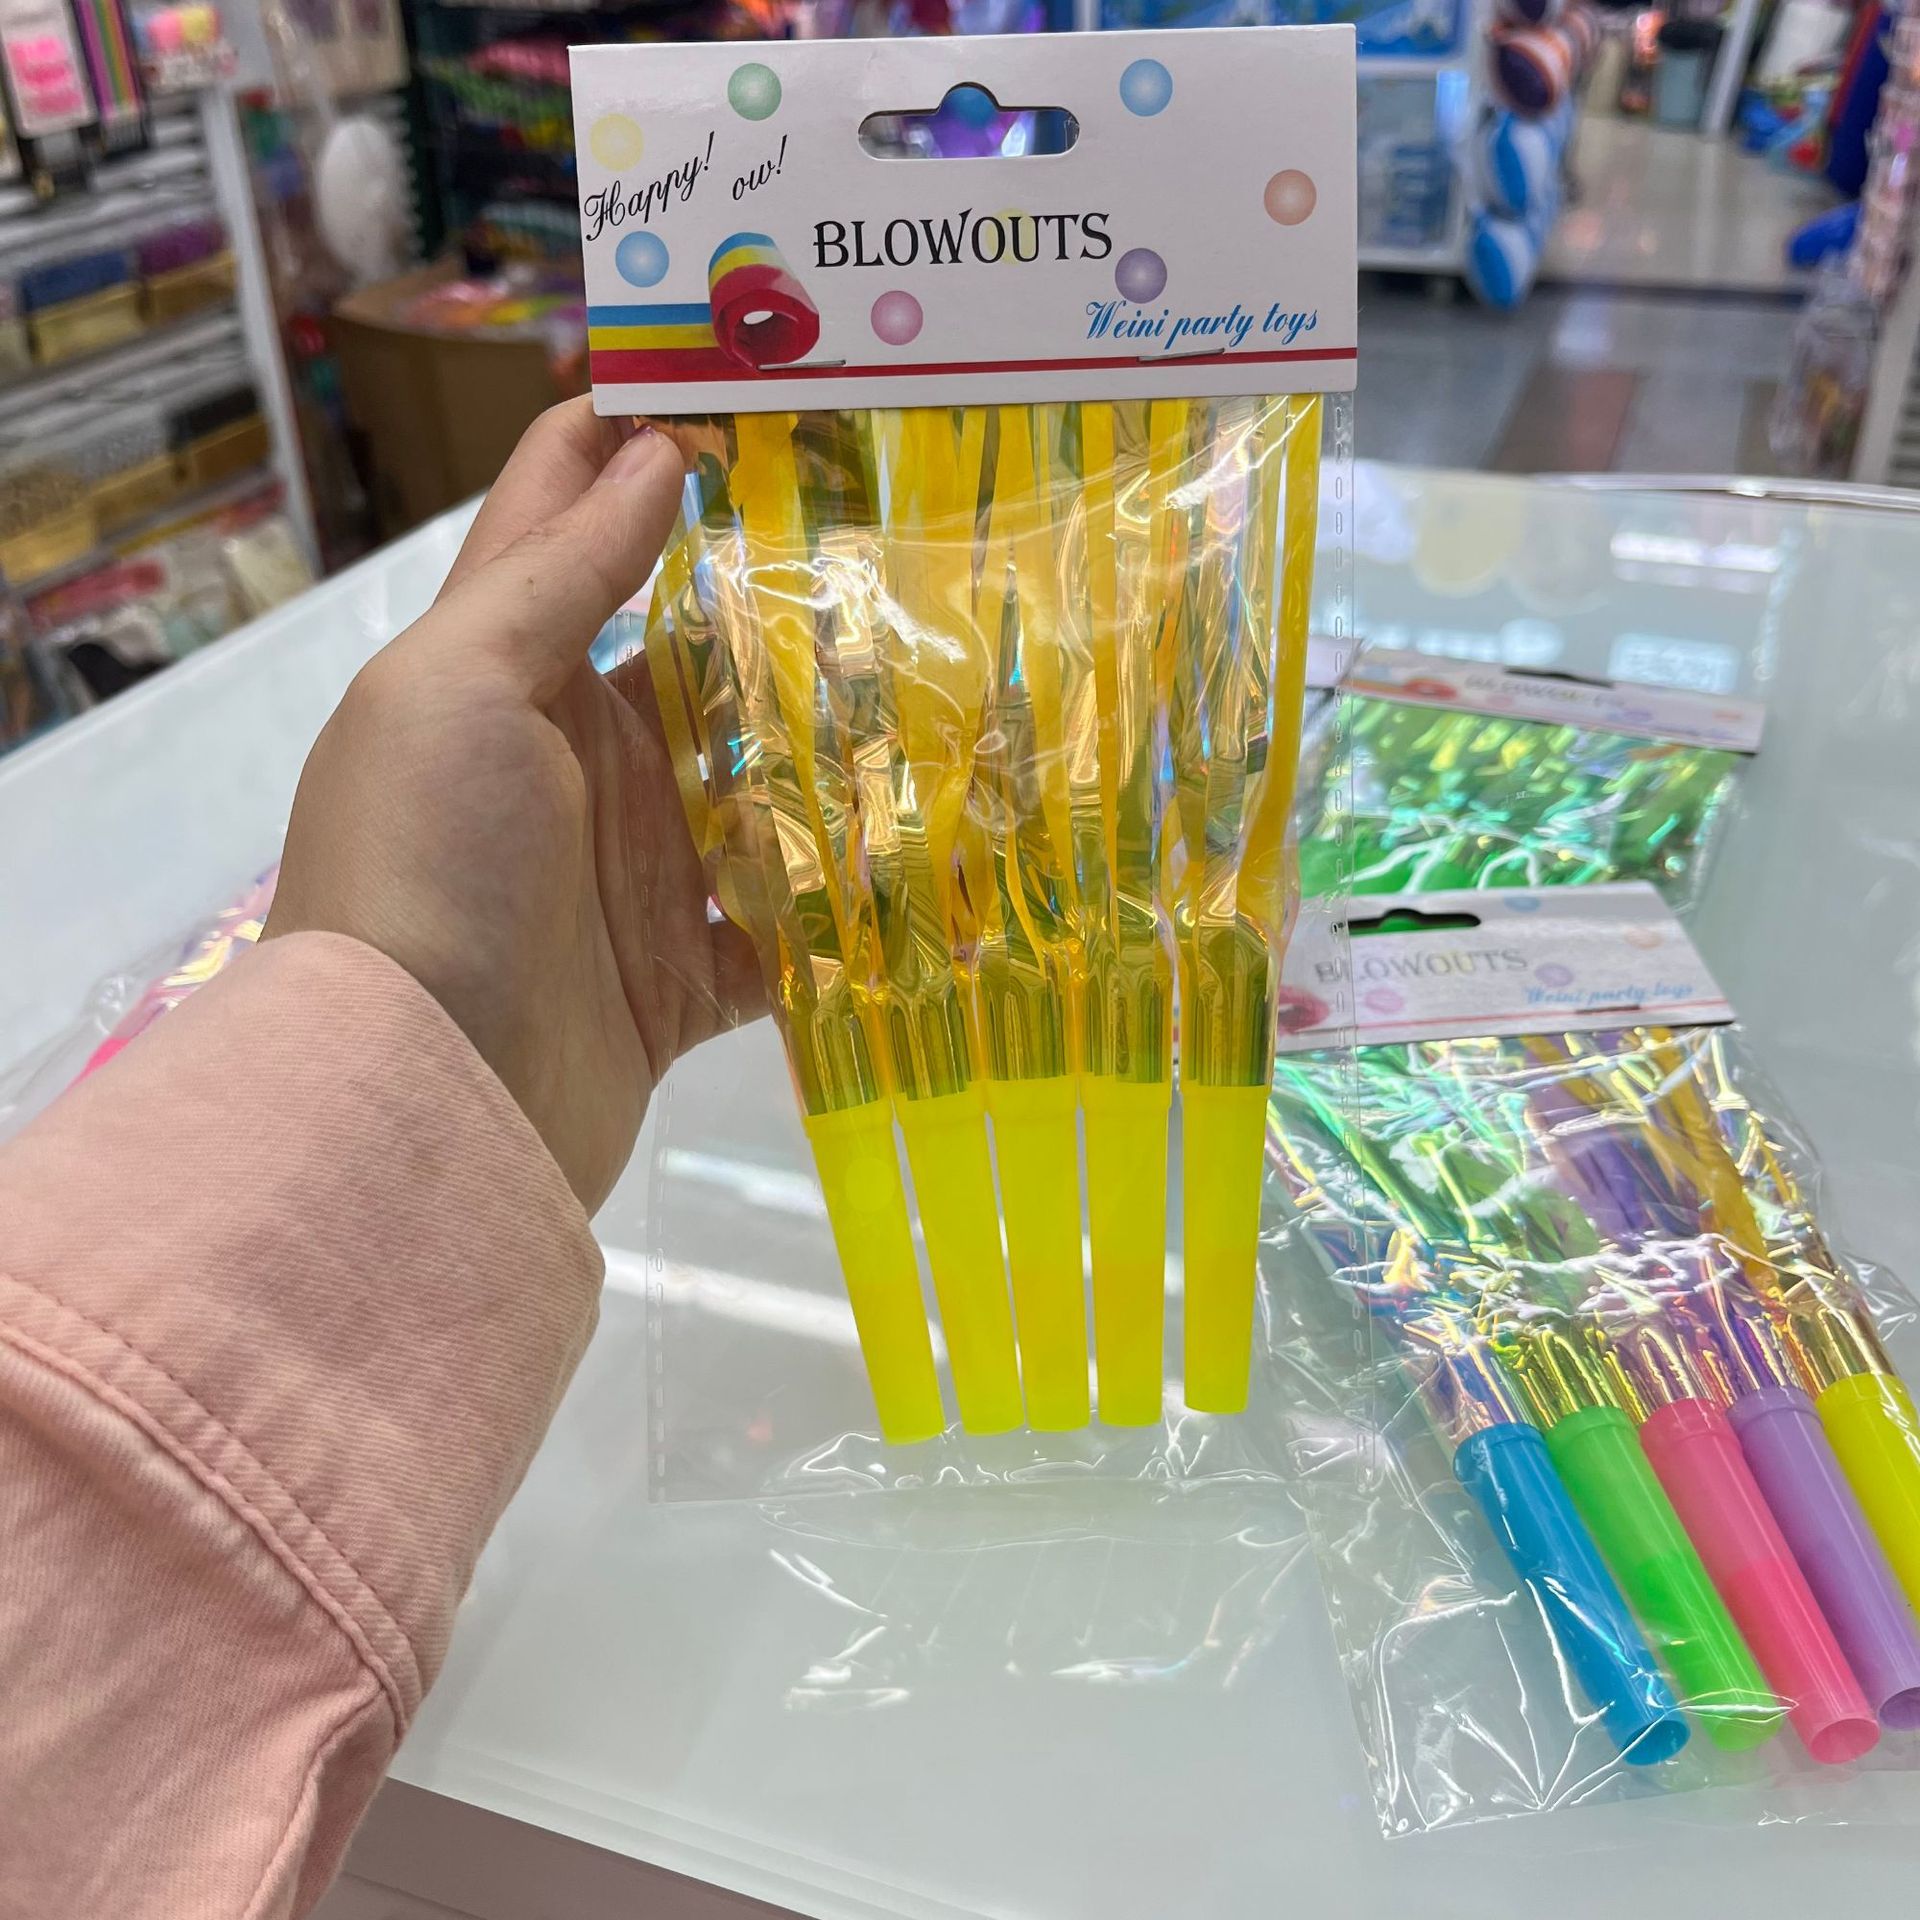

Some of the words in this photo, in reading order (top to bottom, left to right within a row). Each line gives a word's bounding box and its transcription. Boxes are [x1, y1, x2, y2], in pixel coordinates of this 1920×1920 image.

[584, 131, 715, 241] Happy!
[732, 134, 788, 200] ow!
[813, 207, 1113, 268] BLOWOUTS
[1085, 300, 1170, 340] Weini
[1164, 304, 1255, 350] party
[1262, 303, 1318, 346] toys
